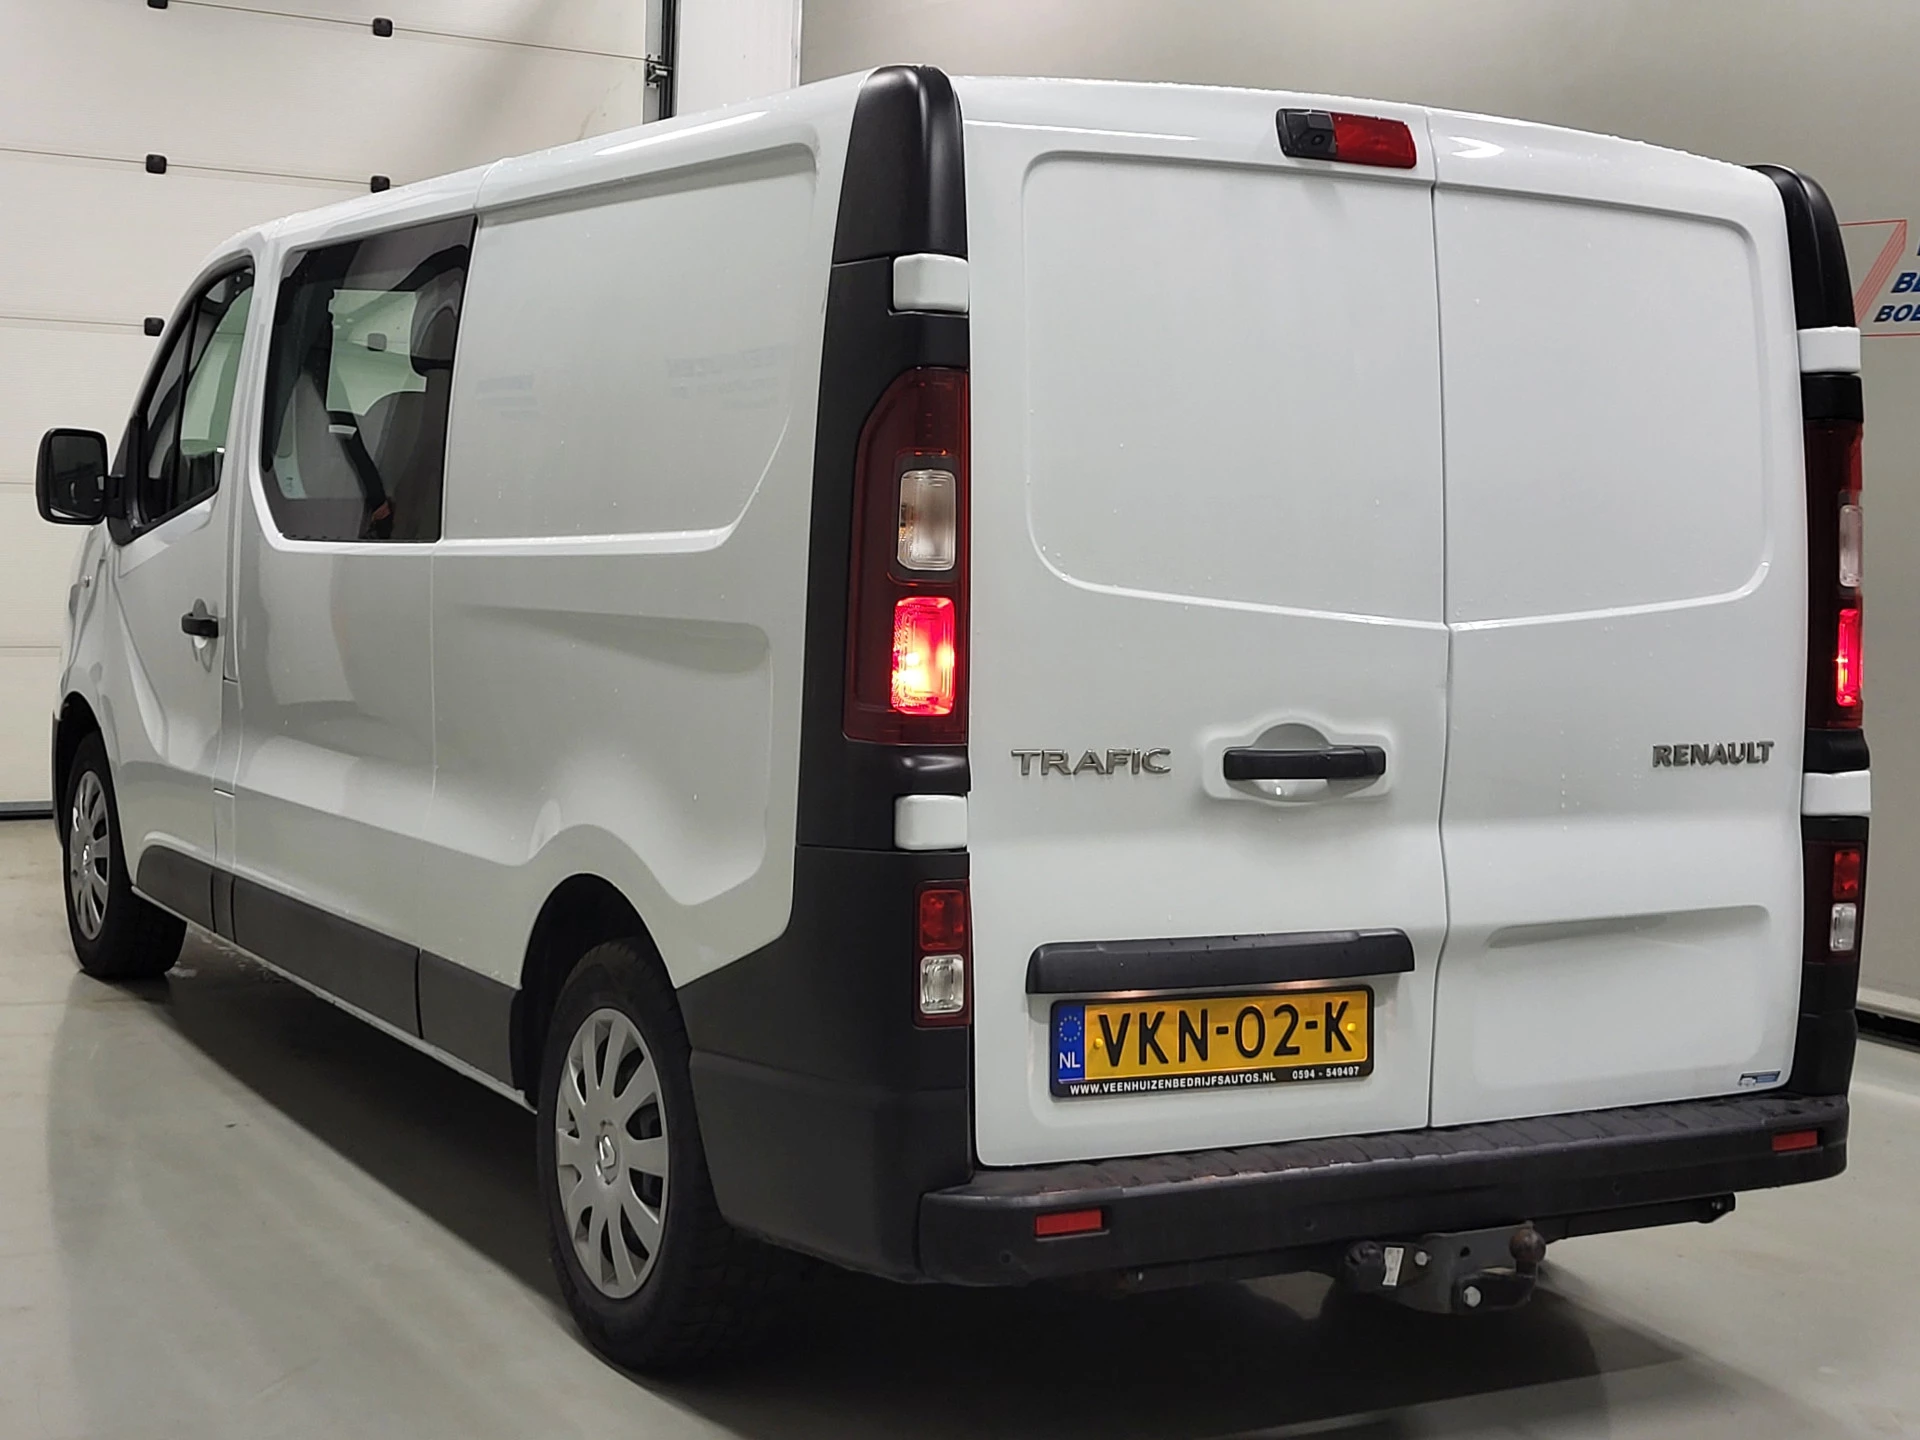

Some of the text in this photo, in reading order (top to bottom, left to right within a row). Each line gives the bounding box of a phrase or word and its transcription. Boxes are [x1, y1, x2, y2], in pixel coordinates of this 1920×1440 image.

[1012, 748, 1171, 776] TRAFIC
[1652, 741, 1775, 767] RENAULT
[1099, 1001, 1352, 1067] VKN-02-K
[1059, 1052, 1081, 1069] NL
[1070, 1073, 1276, 1095] WWW.VEENHUIZENBEDRIJFSAUTOS.NL
[1292, 1069, 1316, 1080] 0594
